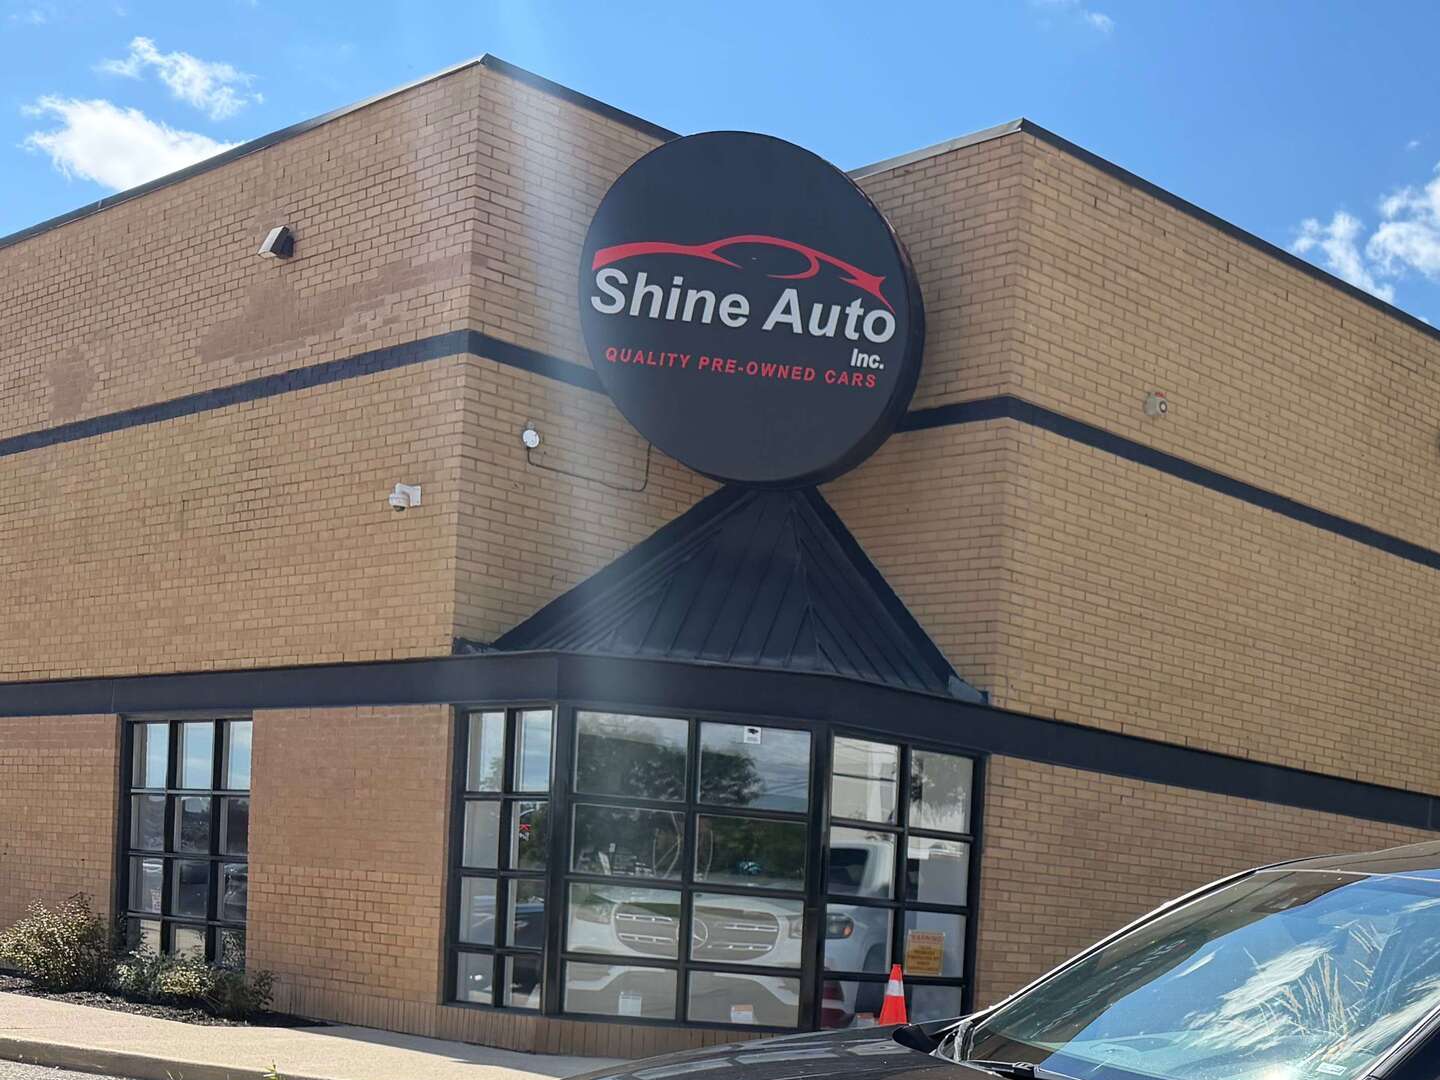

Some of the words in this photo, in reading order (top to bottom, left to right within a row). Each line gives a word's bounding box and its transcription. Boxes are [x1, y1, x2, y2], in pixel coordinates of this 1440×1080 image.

[591, 268, 750, 327] Shine
[762, 288, 896, 343] Auto
[606, 347, 691, 369] QUALITY
[698, 356, 816, 382] PRE-OWNED
[824, 370, 877, 389] CARS
[850, 348, 885, 370] Inc.
